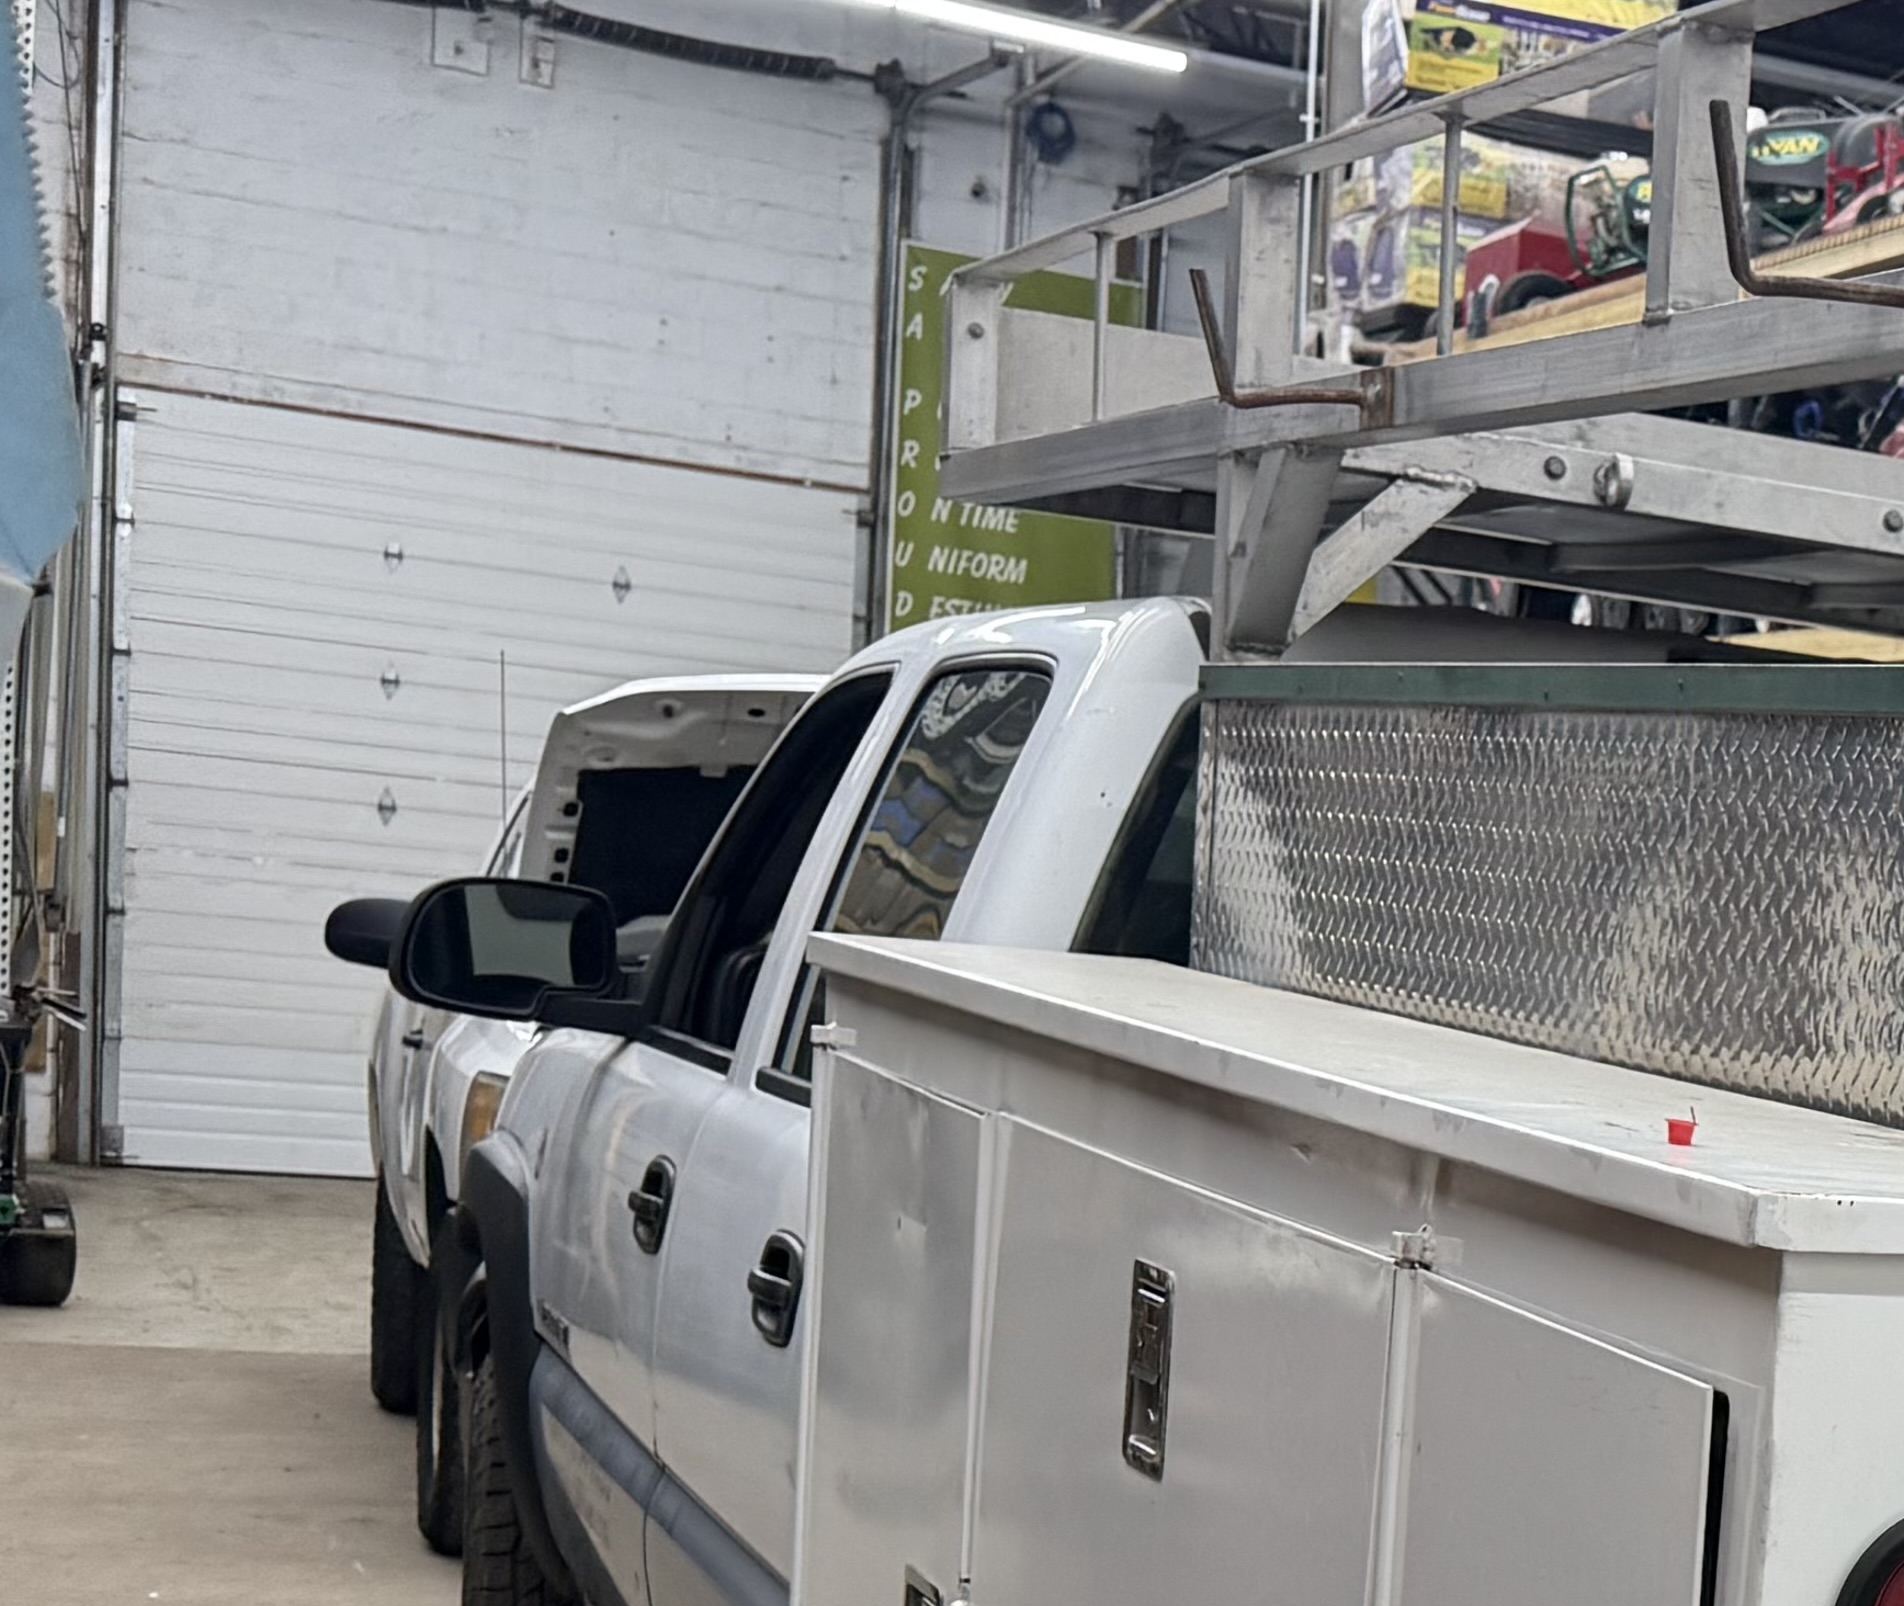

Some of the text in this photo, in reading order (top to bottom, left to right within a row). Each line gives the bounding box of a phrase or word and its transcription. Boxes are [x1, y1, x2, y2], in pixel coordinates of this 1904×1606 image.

[905, 313, 924, 342] A
[903, 389, 923, 416] P
[900, 439, 920, 469] R
[959, 502, 1021, 534] TIME
